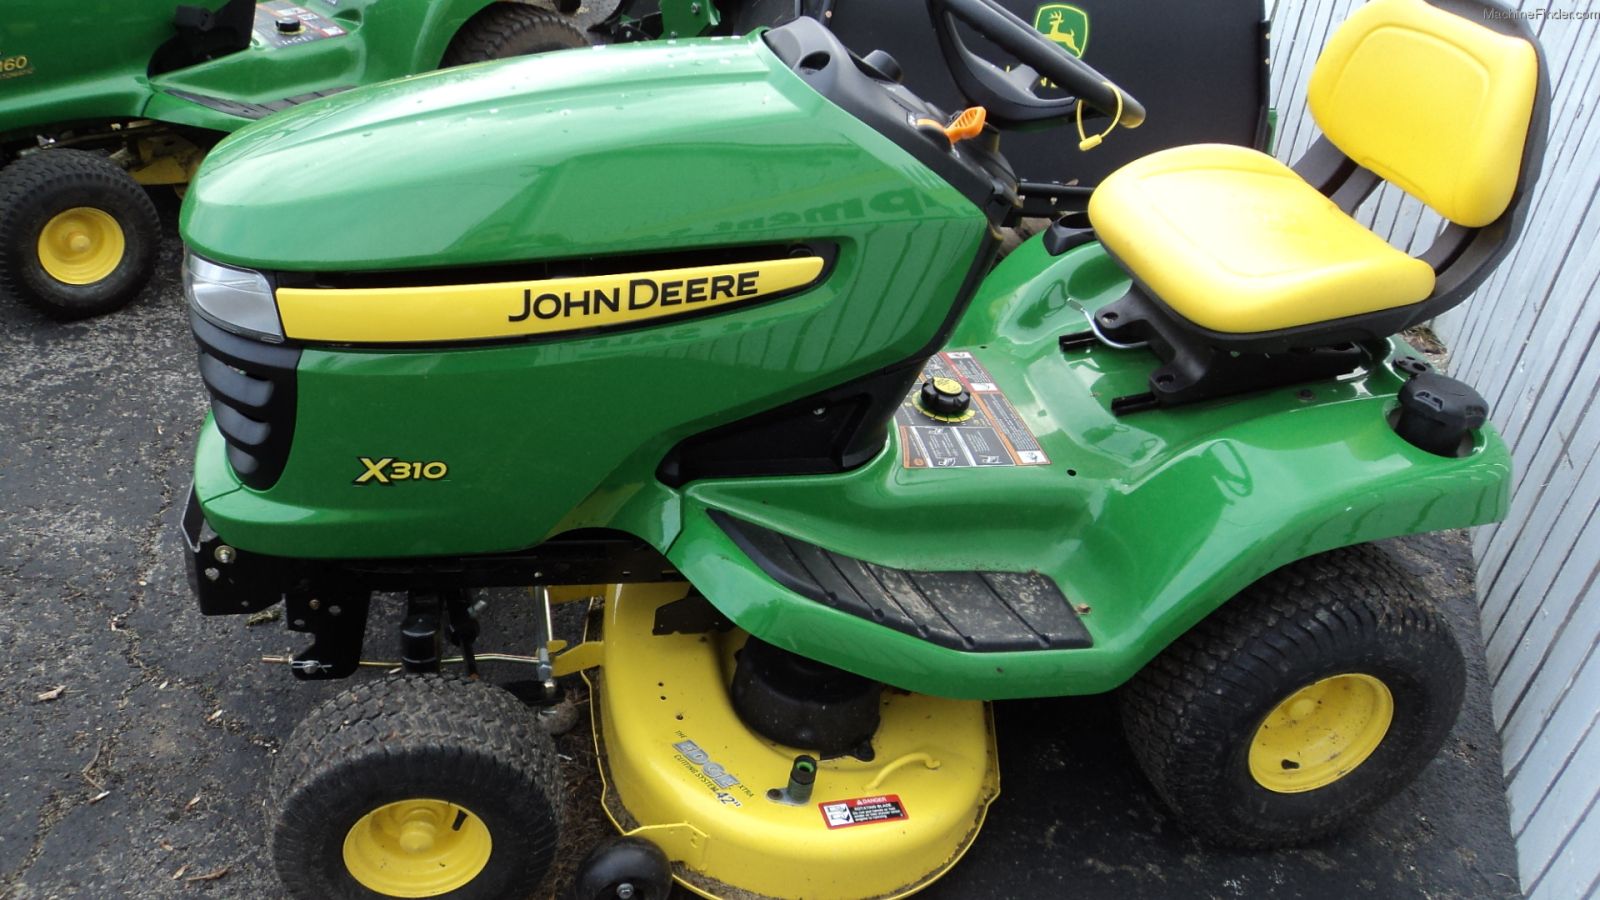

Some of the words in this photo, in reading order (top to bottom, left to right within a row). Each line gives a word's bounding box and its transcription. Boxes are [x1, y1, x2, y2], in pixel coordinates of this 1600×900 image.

[508, 288, 620, 322] JOHN
[628, 271, 760, 310] DEERE
[353, 457, 449, 484] X310
[672, 740, 740, 789] EDGE
[862, 797, 887, 805] DANGER
